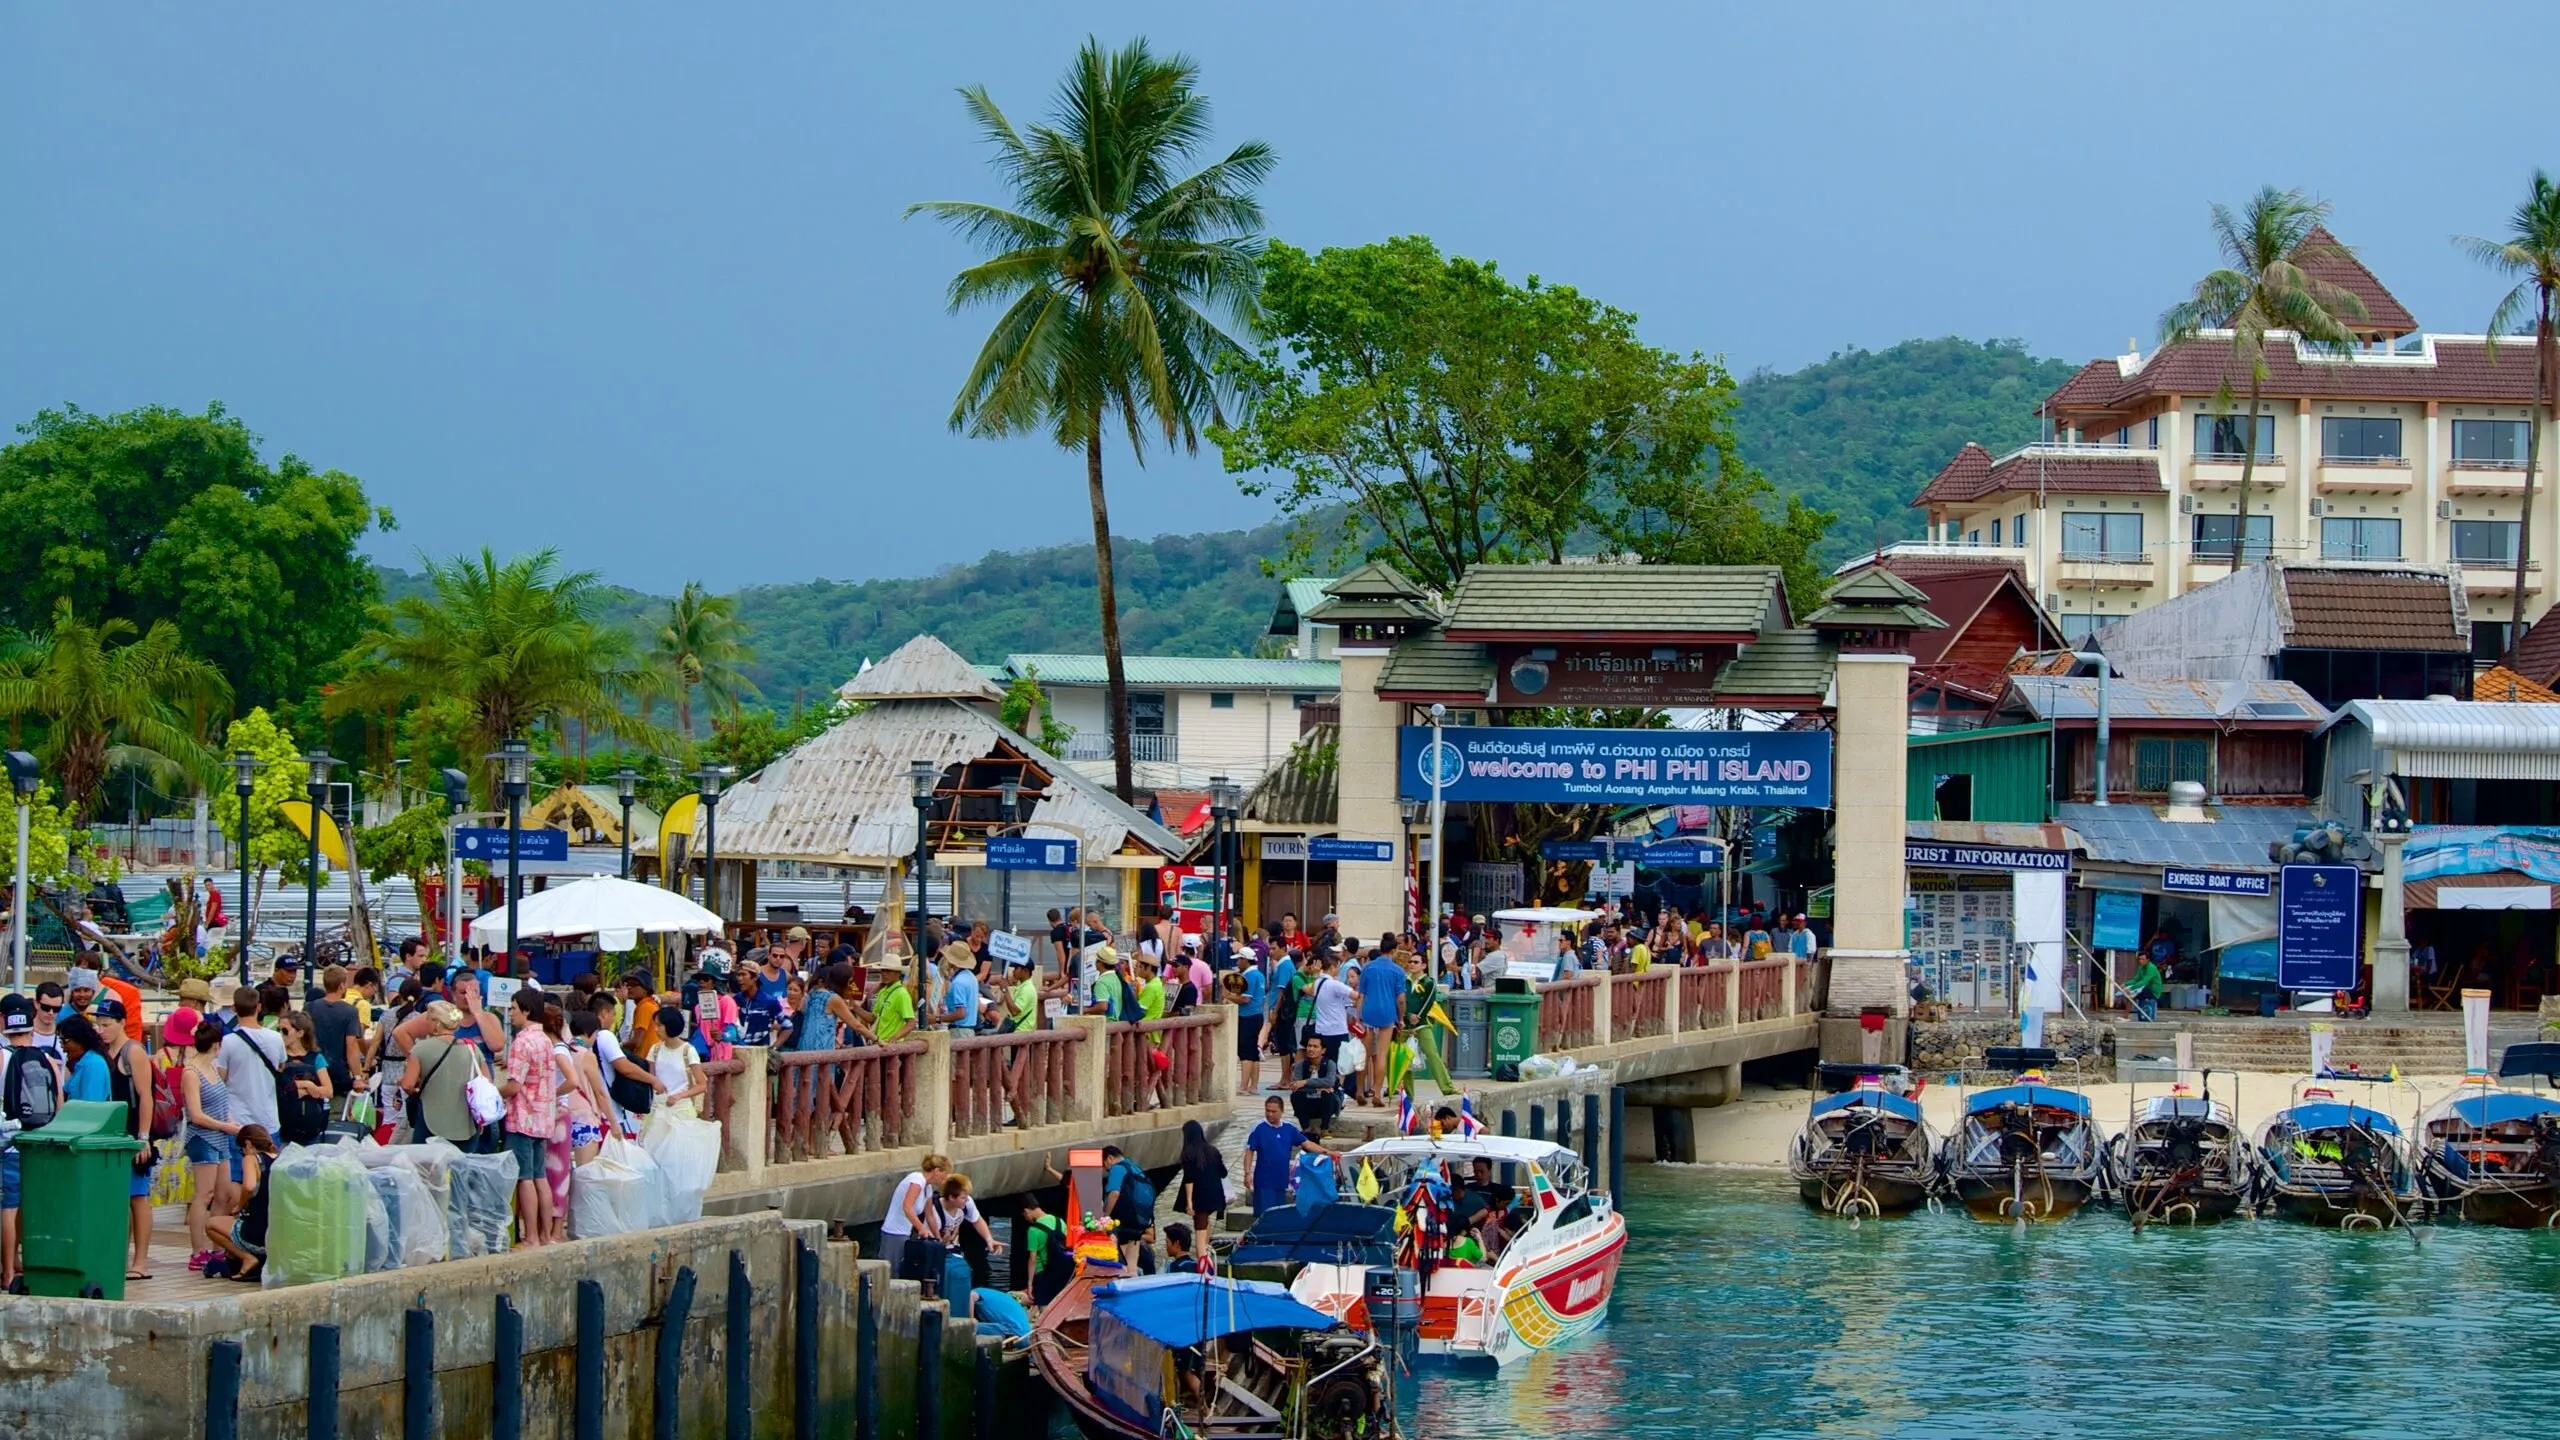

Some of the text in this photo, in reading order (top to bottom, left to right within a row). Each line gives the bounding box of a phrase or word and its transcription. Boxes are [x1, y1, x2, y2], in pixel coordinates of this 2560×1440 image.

[1644, 675, 1664, 684] PIER
[1468, 741, 1750, 758] ยินดีต้อนรับสู่ เกาะพีพี ต.อ่าวนาง อ.เมือง จ.กระบี่
[1468, 757, 1573, 778] welcome
[1582, 759, 1606, 779] to
[1615, 759, 1657, 780] PHI
[1666, 760, 1709, 781] PHI
[1718, 760, 1811, 781] ISLAND
[1564, 783, 1807, 796] Tumbol Aonang Amphur Muang Krabi, Thailand
[1266, 841, 1304, 854] TOURIS
[1905, 847, 2066, 868] URIST INFORMATION
[2168, 872, 2265, 890] EXPRESS BOAT OFFICE
